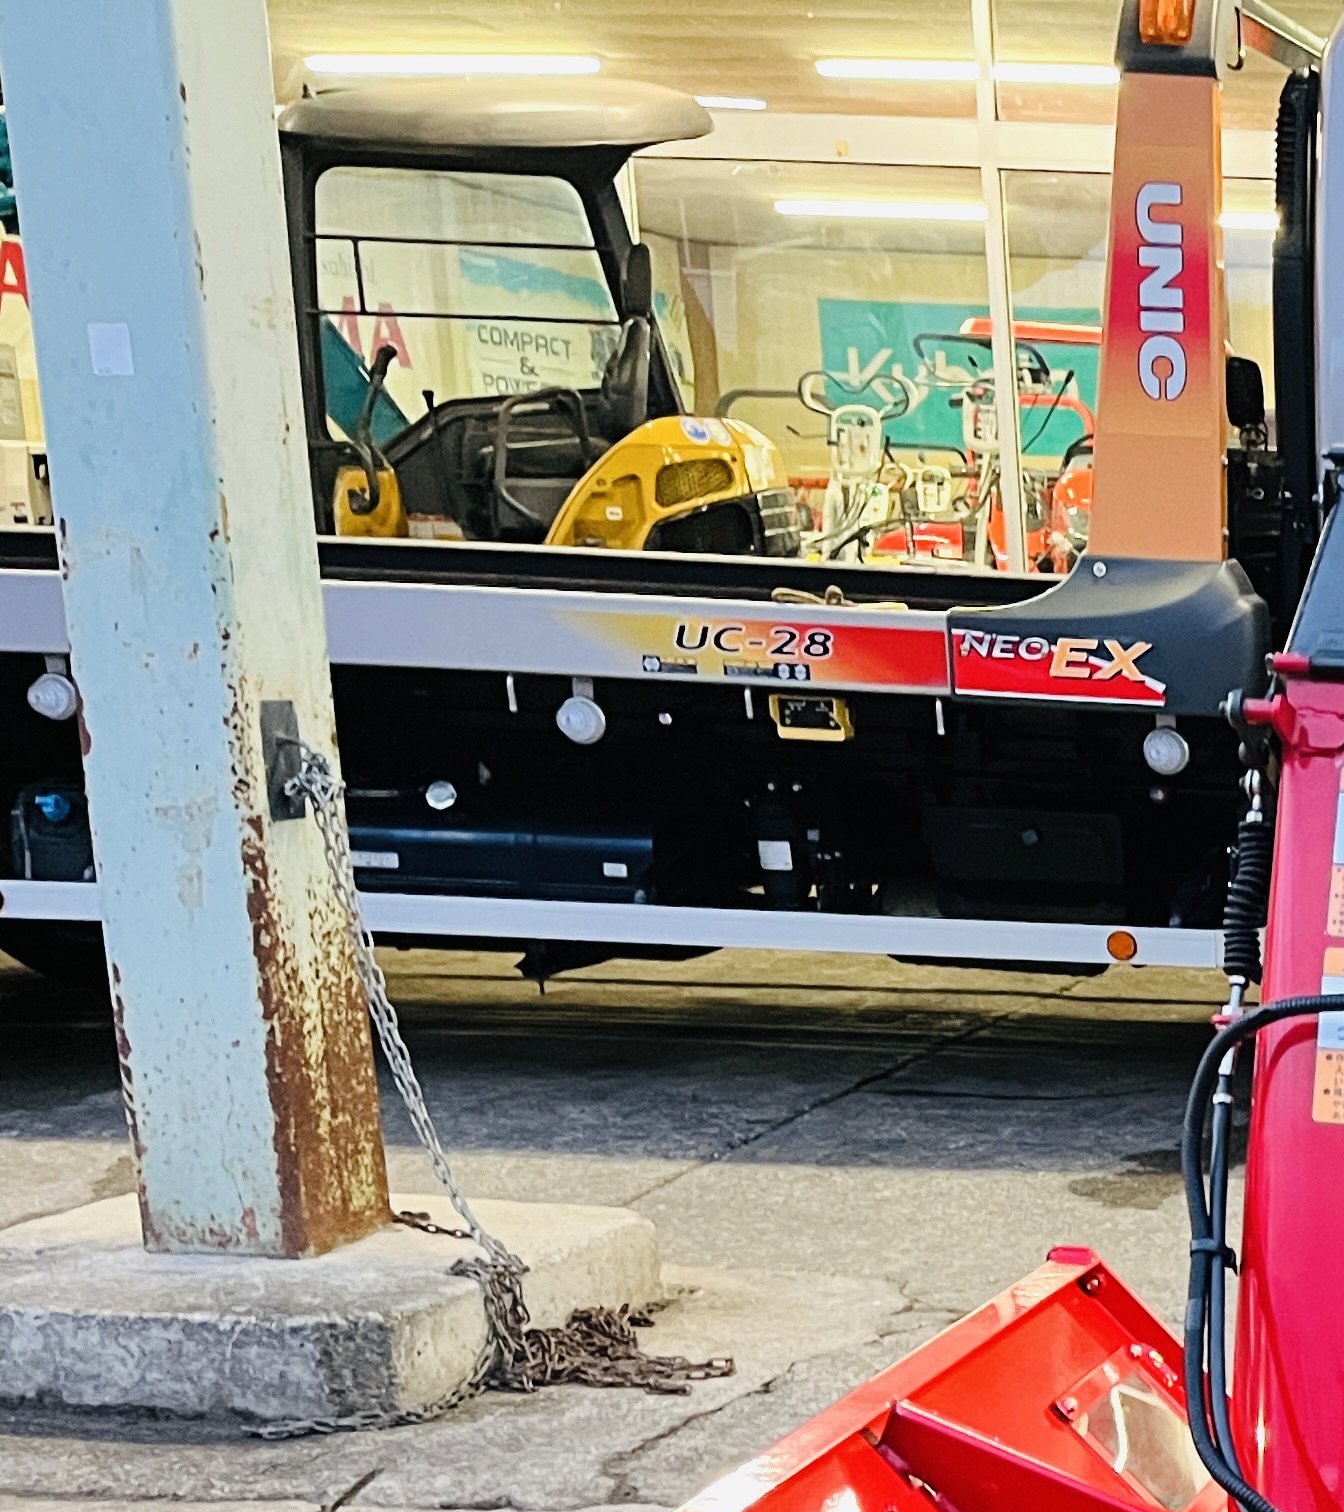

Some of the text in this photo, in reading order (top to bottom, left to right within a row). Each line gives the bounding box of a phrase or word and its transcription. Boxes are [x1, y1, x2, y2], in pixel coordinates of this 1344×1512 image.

[1135, 182, 1188, 402] UNIC
[477, 323, 571, 361] COMPACT
[520, 356, 541, 377] &
[846, 346, 1079, 414] Kuba
[675, 623, 833, 657] UC-28
[1048, 637, 1153, 681] EX
